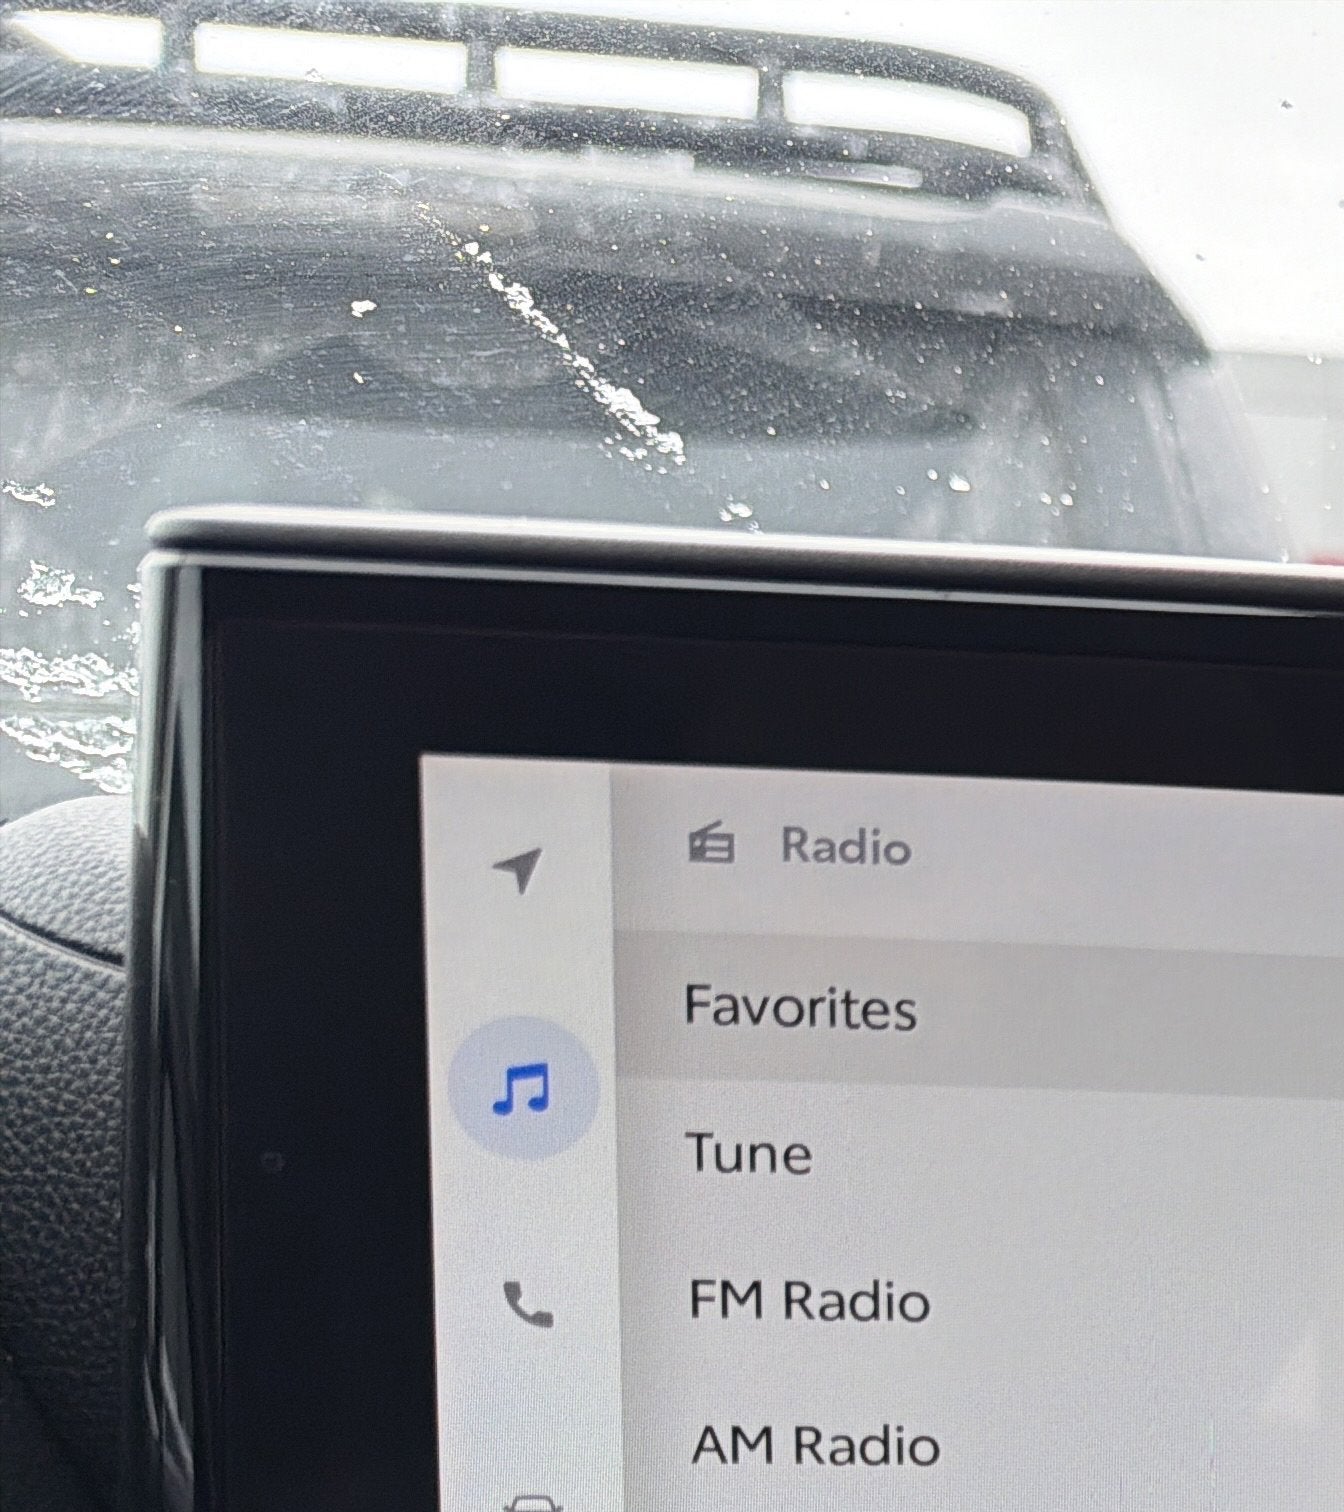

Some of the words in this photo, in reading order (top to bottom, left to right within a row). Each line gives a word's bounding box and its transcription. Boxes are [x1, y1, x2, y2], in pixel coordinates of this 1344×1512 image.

[783, 826, 911, 865] Radio
[686, 984, 916, 1031] Favorites
[685, 1132, 811, 1175] Tune
[692, 1279, 762, 1318] FM
[785, 1279, 930, 1322] Radio
[692, 1426, 772, 1463] AM
[795, 1424, 940, 1466] Radio
